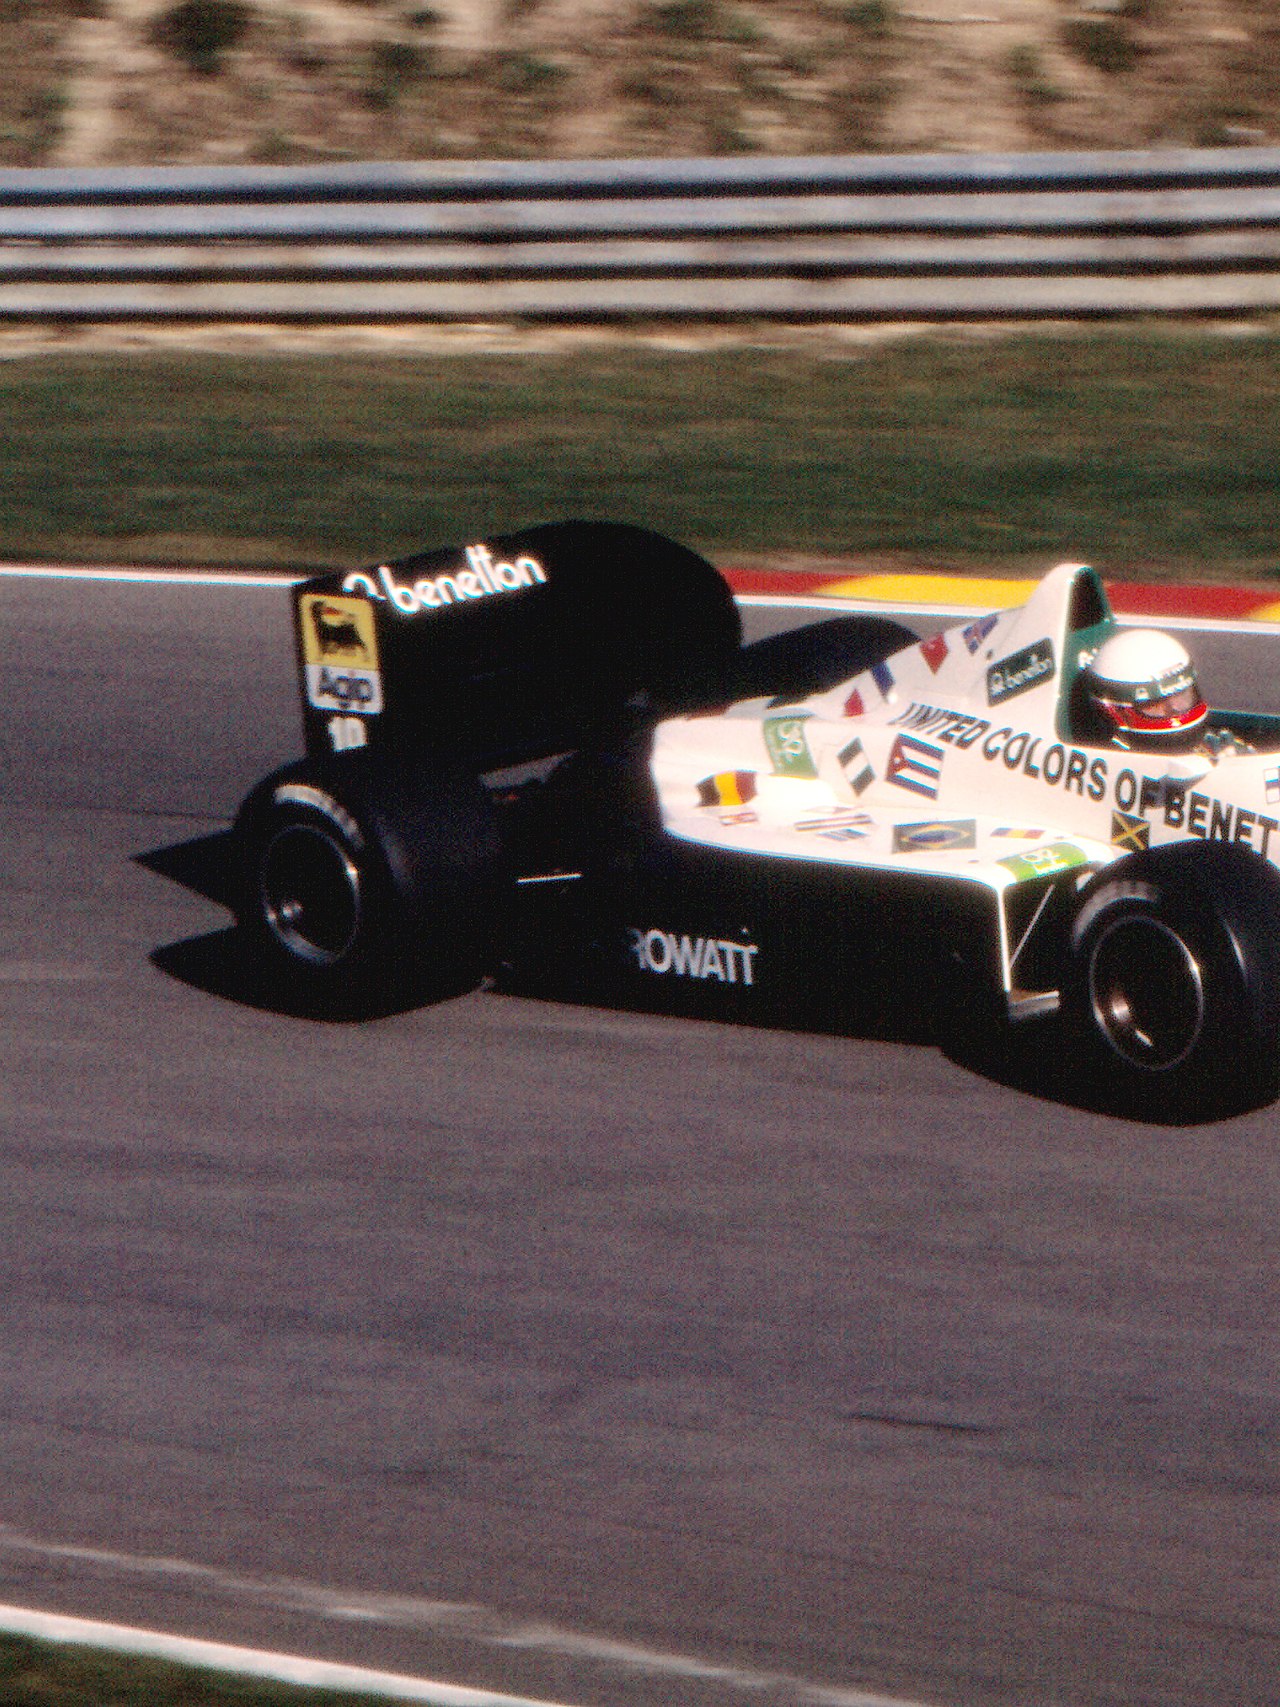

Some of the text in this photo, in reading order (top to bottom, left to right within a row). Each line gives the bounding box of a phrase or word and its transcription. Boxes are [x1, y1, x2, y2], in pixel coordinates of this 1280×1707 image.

[378, 543, 548, 615] benetton
[887, 702, 992, 750] UNITED
[981, 727, 1108, 802] COLORS
[1114, 767, 1168, 817] OF
